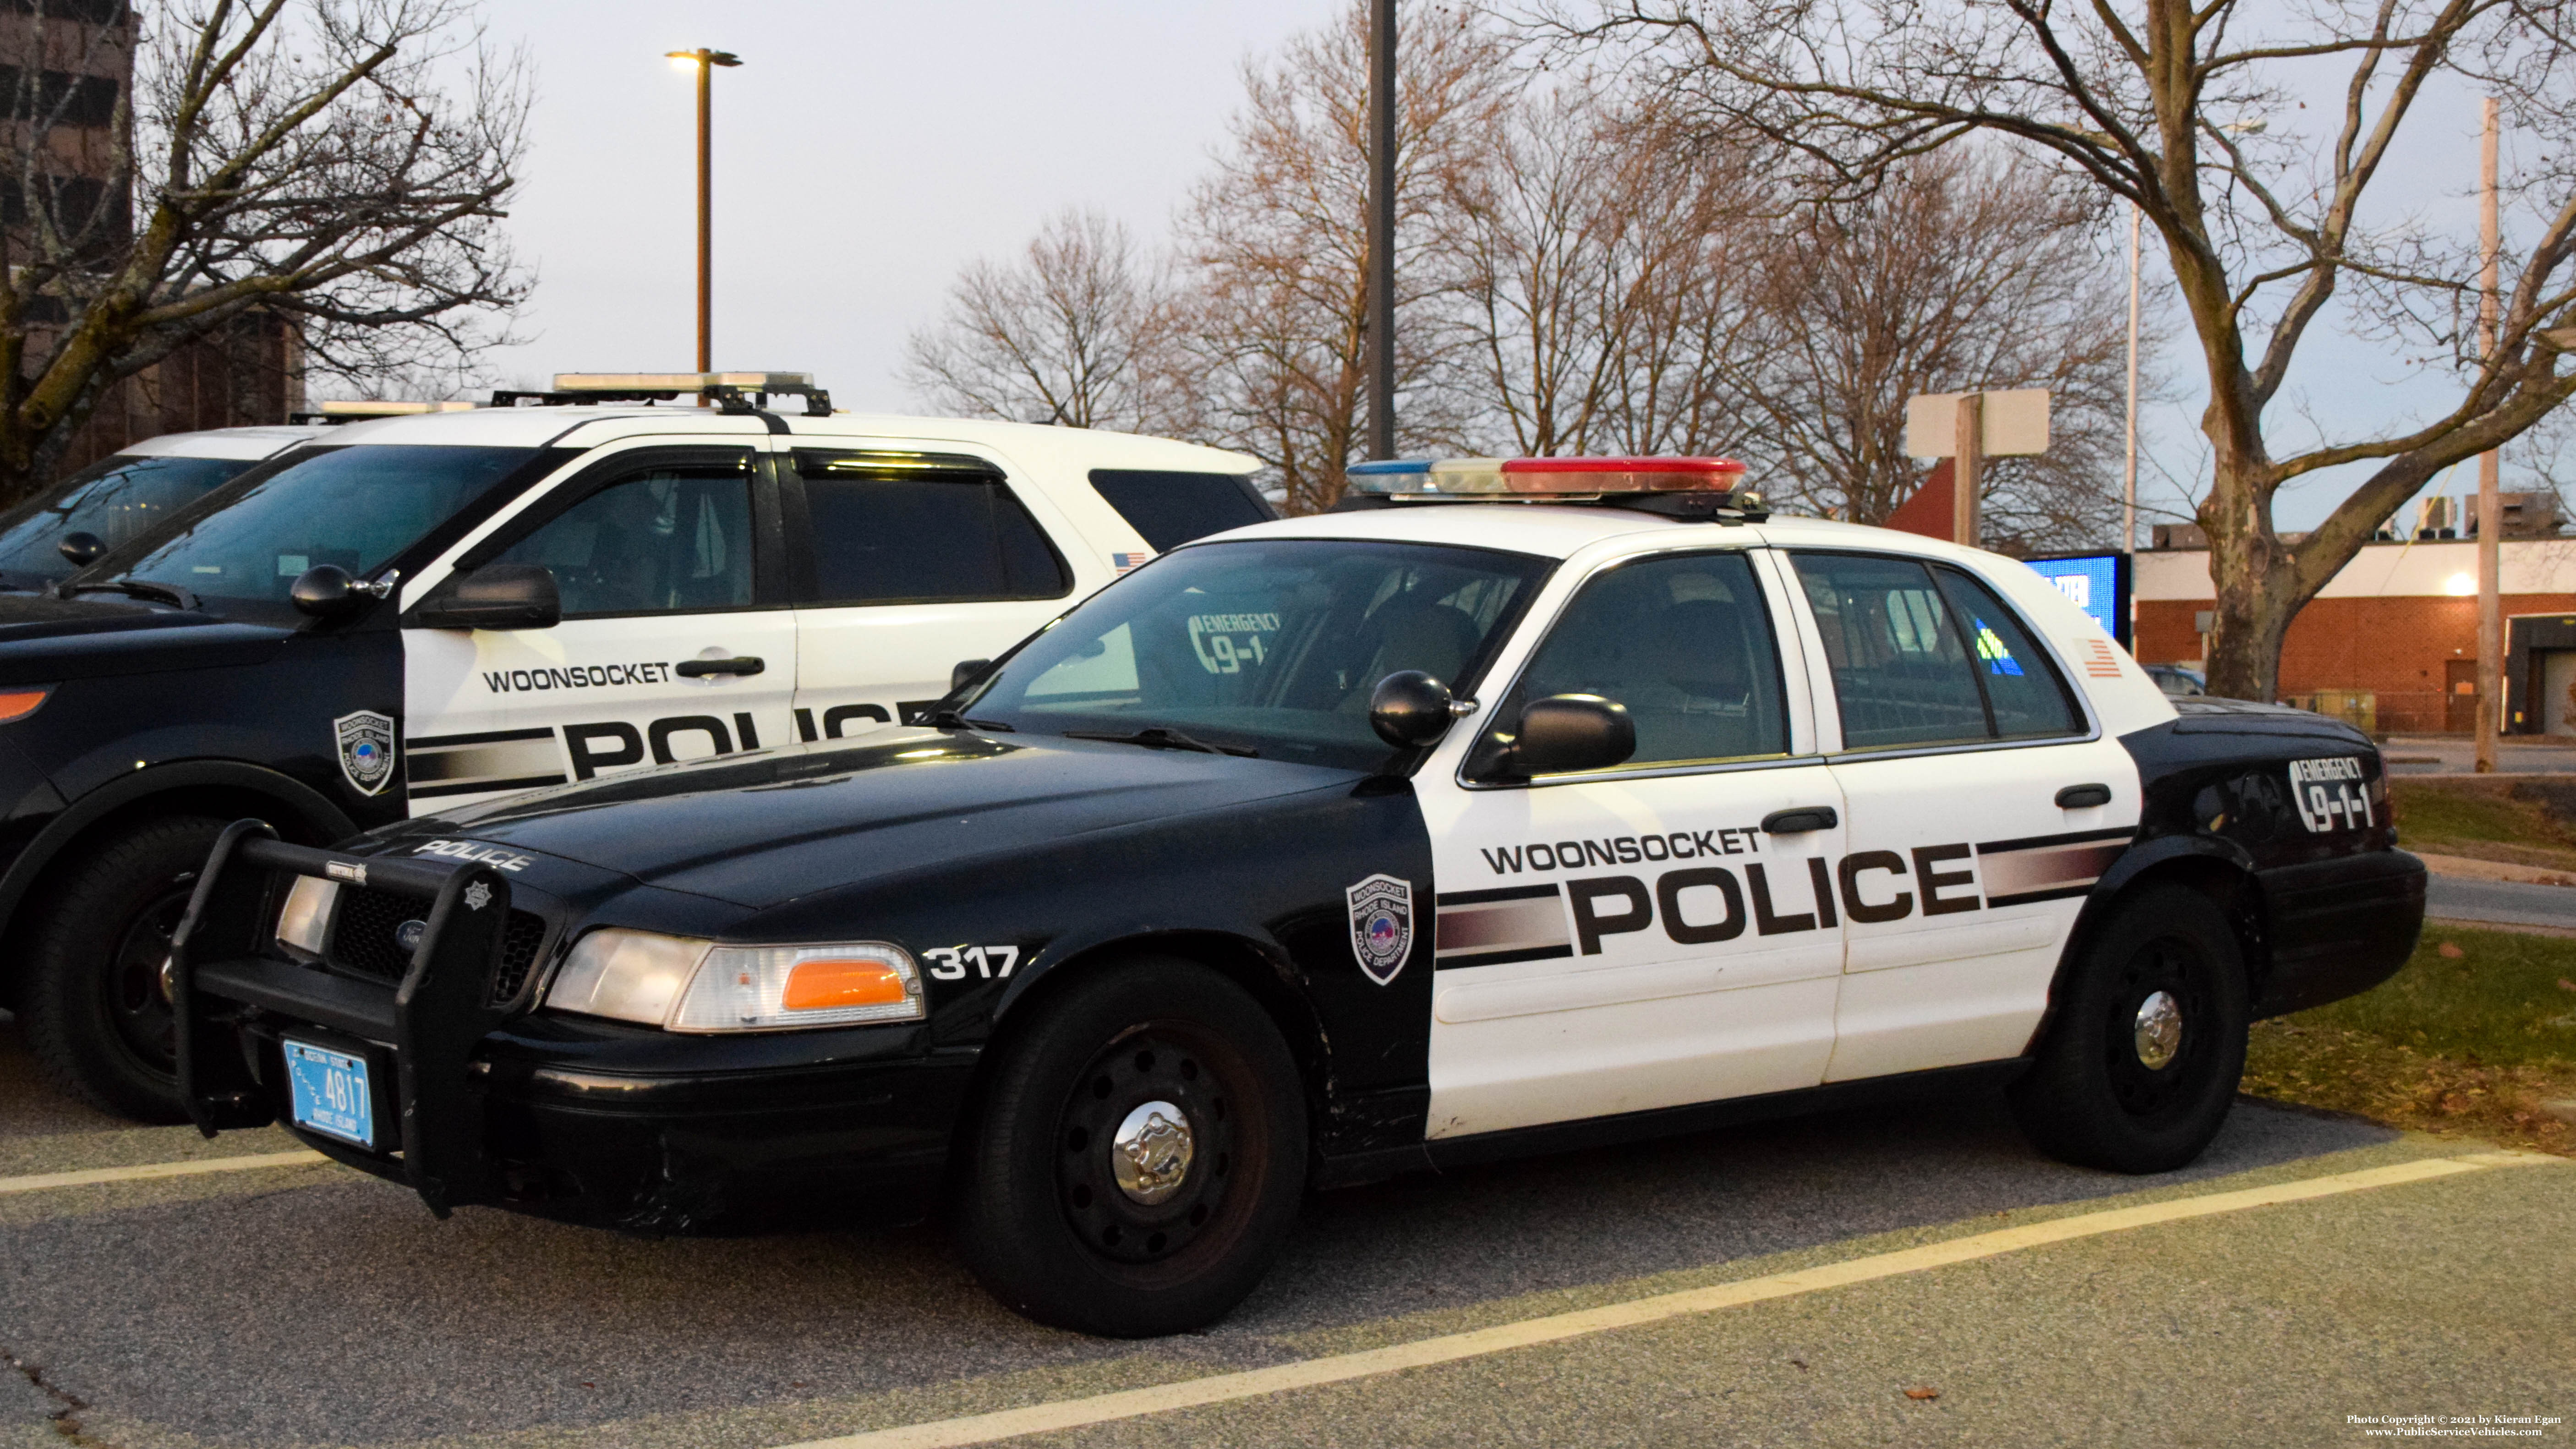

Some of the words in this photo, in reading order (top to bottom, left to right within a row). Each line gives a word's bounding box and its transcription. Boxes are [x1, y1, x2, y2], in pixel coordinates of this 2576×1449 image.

[1202, 612, 1280, 633] EMERGENCY
[482, 662, 669, 693] WOONSOCKET
[341, 716, 388, 731] WOONSOCKET
[2299, 757, 2362, 782] EMERGENCY
[2309, 782, 2374, 832] 9-1-1
[413, 840, 536, 872] POLICE
[1481, 826, 1760, 875] WOONSOCKET
[1354, 881, 1405, 902] WOONSOCKET
[1566, 842, 1981, 956] POLICE
[1354, 900, 1379, 921] RHODE
[1380, 899, 1407, 915] ISLAND
[1356, 930, 1373, 962] POLICE
[1373, 927, 1408, 966] DEPARTMENT
[926, 946, 1019, 980] 317
[326, 1068, 365, 1118] 4817
